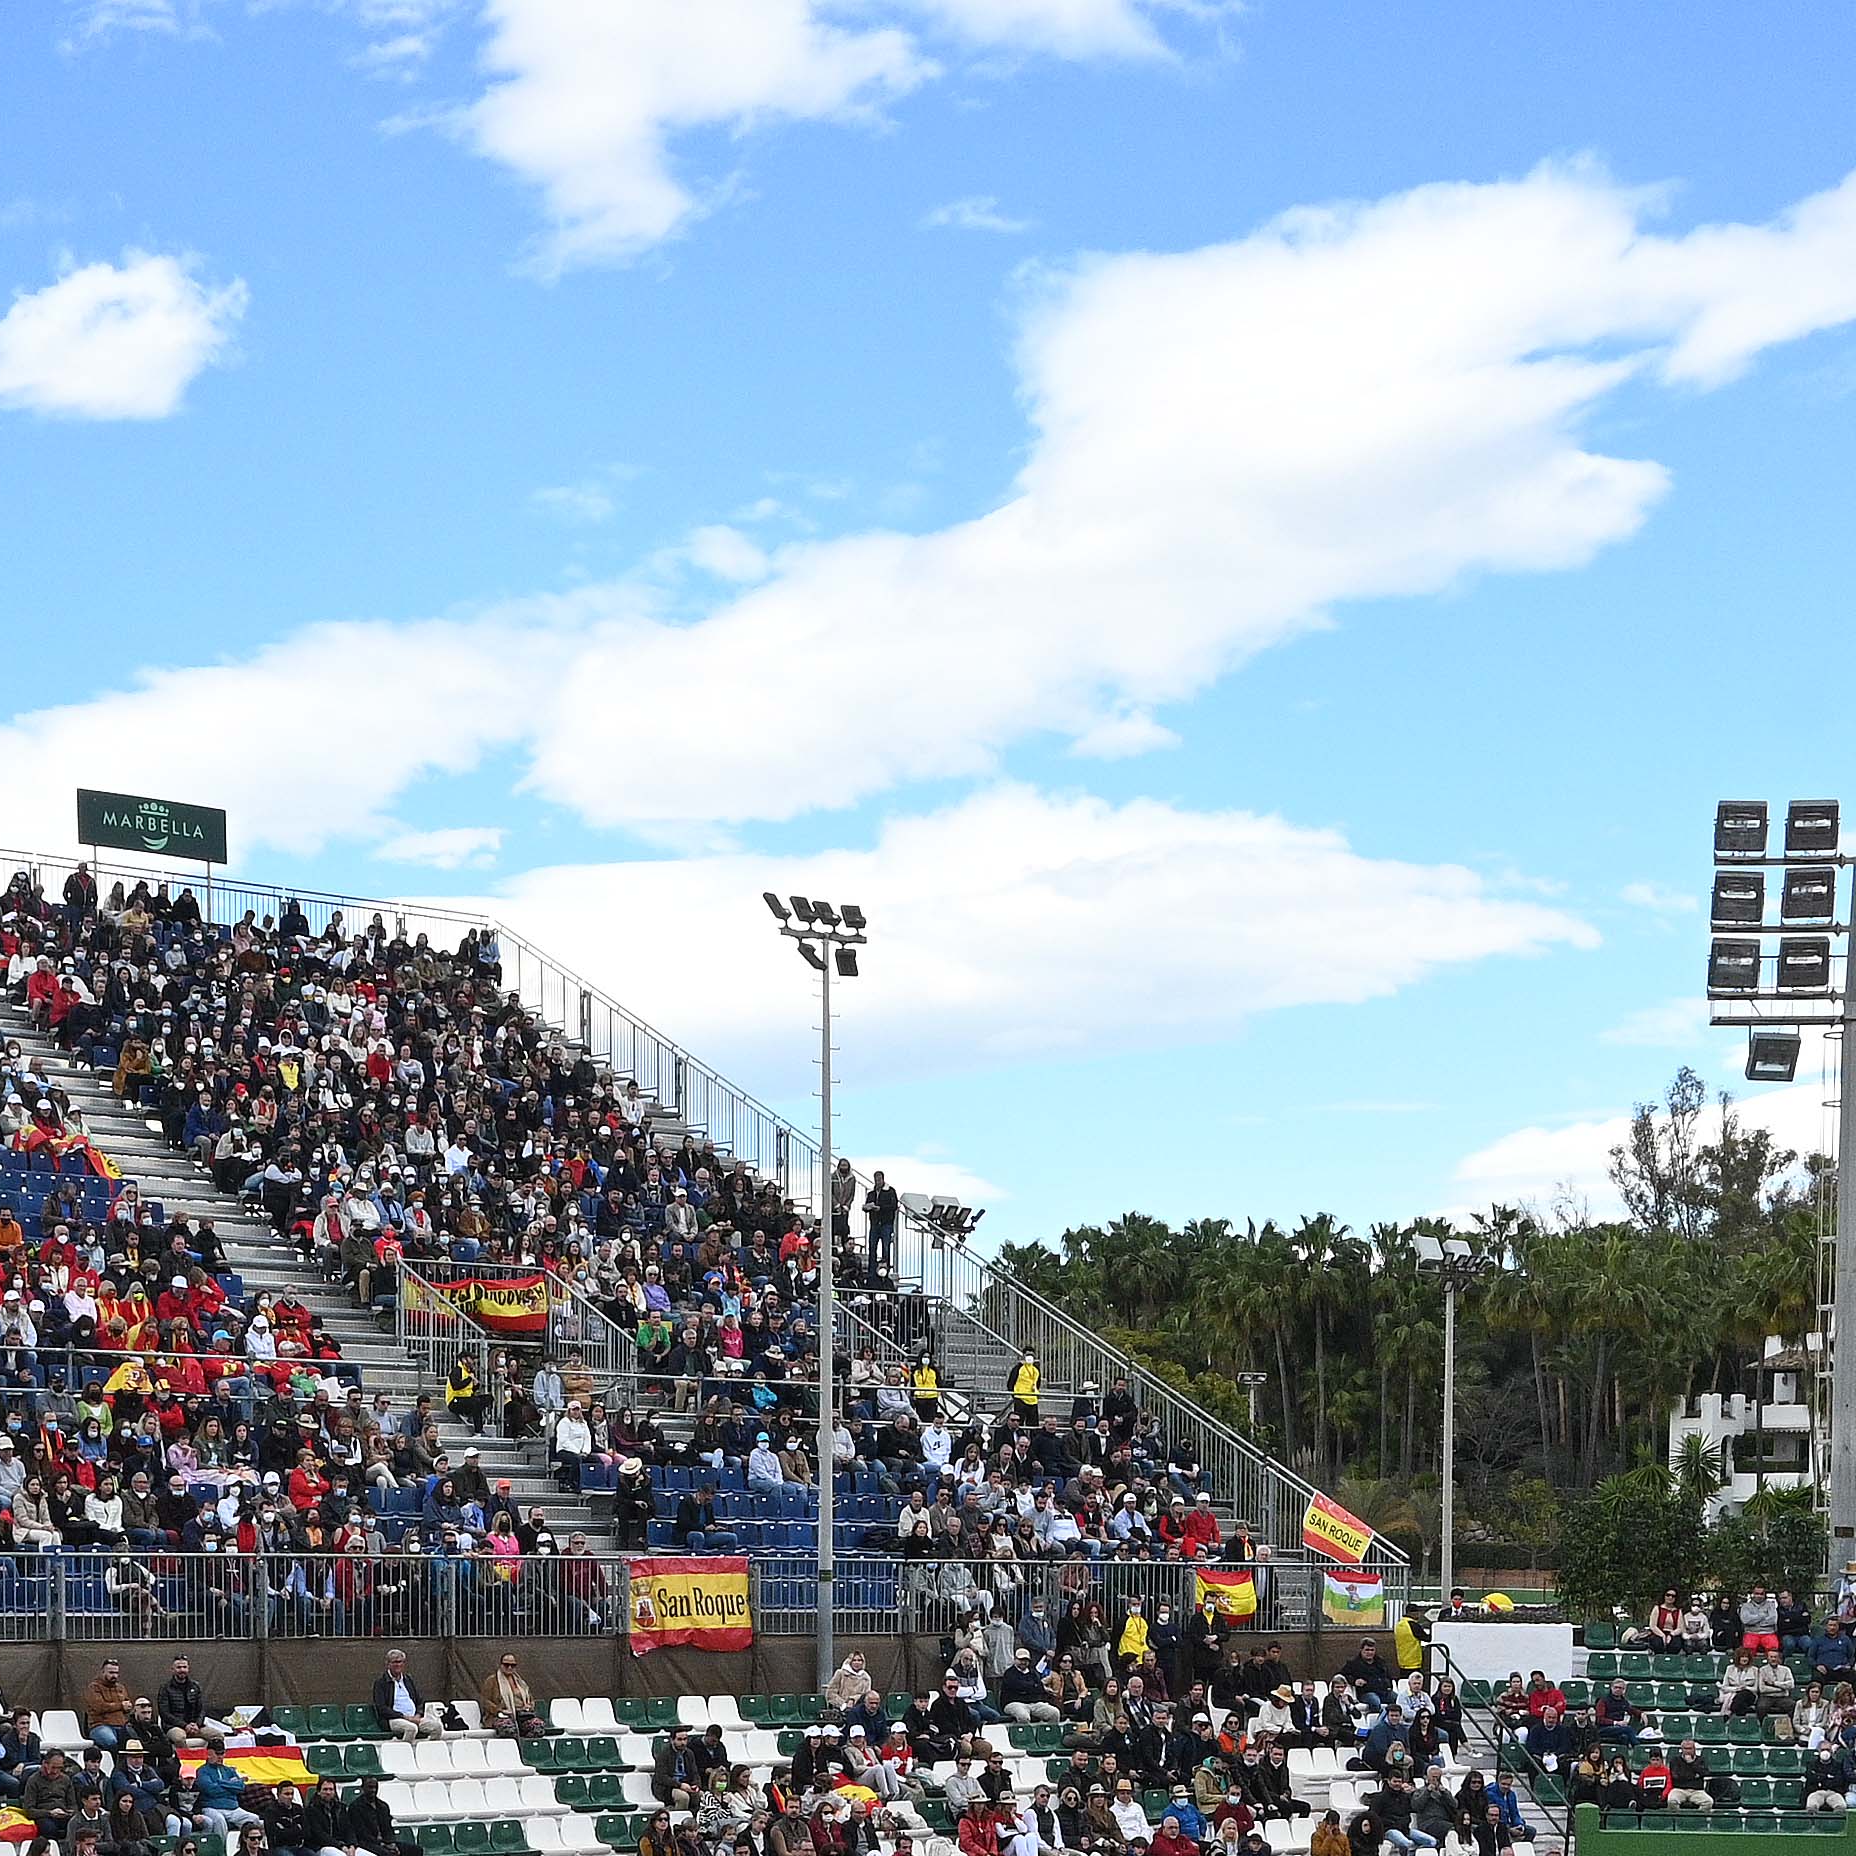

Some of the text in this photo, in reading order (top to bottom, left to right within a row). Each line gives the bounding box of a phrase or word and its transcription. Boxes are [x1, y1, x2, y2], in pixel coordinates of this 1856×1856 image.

[103, 811, 204, 839] MARBELLA
[1309, 1513, 1363, 1552] SAN ROQUE
[657, 1587, 746, 1624] San Roque
